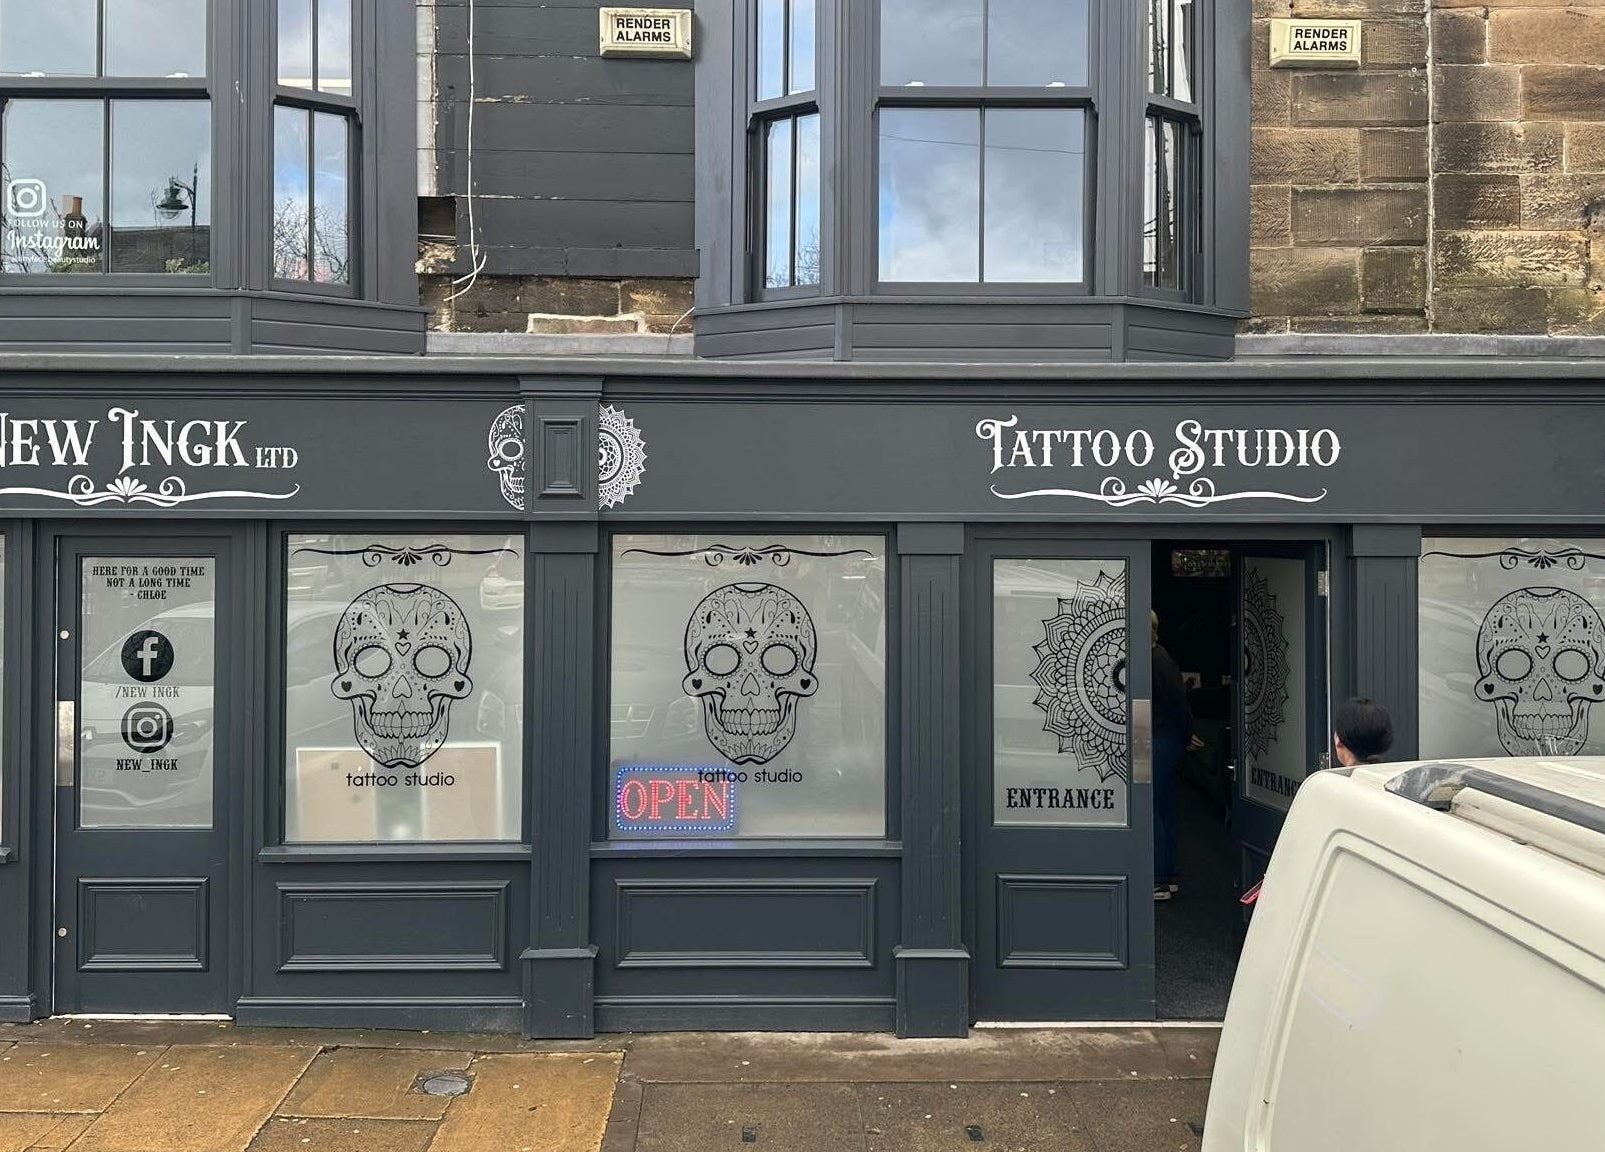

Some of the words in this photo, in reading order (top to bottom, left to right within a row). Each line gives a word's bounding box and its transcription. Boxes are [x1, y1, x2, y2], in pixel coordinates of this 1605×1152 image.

[616, 18, 671, 29] RENDER
[616, 31, 671, 42] ALARMS
[1295, 28, 1348, 39] RENDER
[1293, 40, 1347, 51] ALARMS
[8, 218, 49, 228] FOLLOW
[52, 219, 66, 228] US
[68, 220, 83, 228] ON
[7, 229, 101, 257] Instagram
[0, 412, 100, 467] EW
[108, 407, 250, 475] INGK
[255, 447, 299, 469] LTD
[975, 414, 1155, 475] TATTOO
[1168, 419, 1342, 480] STUDIO
[93, 566, 117, 576] HERE
[121, 566, 139, 576] FOR
[142, 567, 149, 576] A
[152, 567, 177, 576] GOOD
[180, 567, 205, 576] TIME
[106, 578, 125, 588] NOT
[129, 578, 135, 588] A
[139, 578, 162, 588] LONG
[166, 578, 191, 588] TIME
[137, 590, 167, 600] CHLOE
[115, 686, 148, 698] /NEW
[152, 686, 180, 698] INGK
[116, 759, 178, 773] NEW_INGK
[346, 772, 398, 787] tattoo
[404, 771, 455, 787] studio
[697, 769, 748, 784] tattoo
[754, 769, 803, 784] studio
[1251, 767, 1300, 798] ENTRANC
[619, 779, 730, 820] OPEN
[1006, 787, 1115, 809] ENTRANCE
